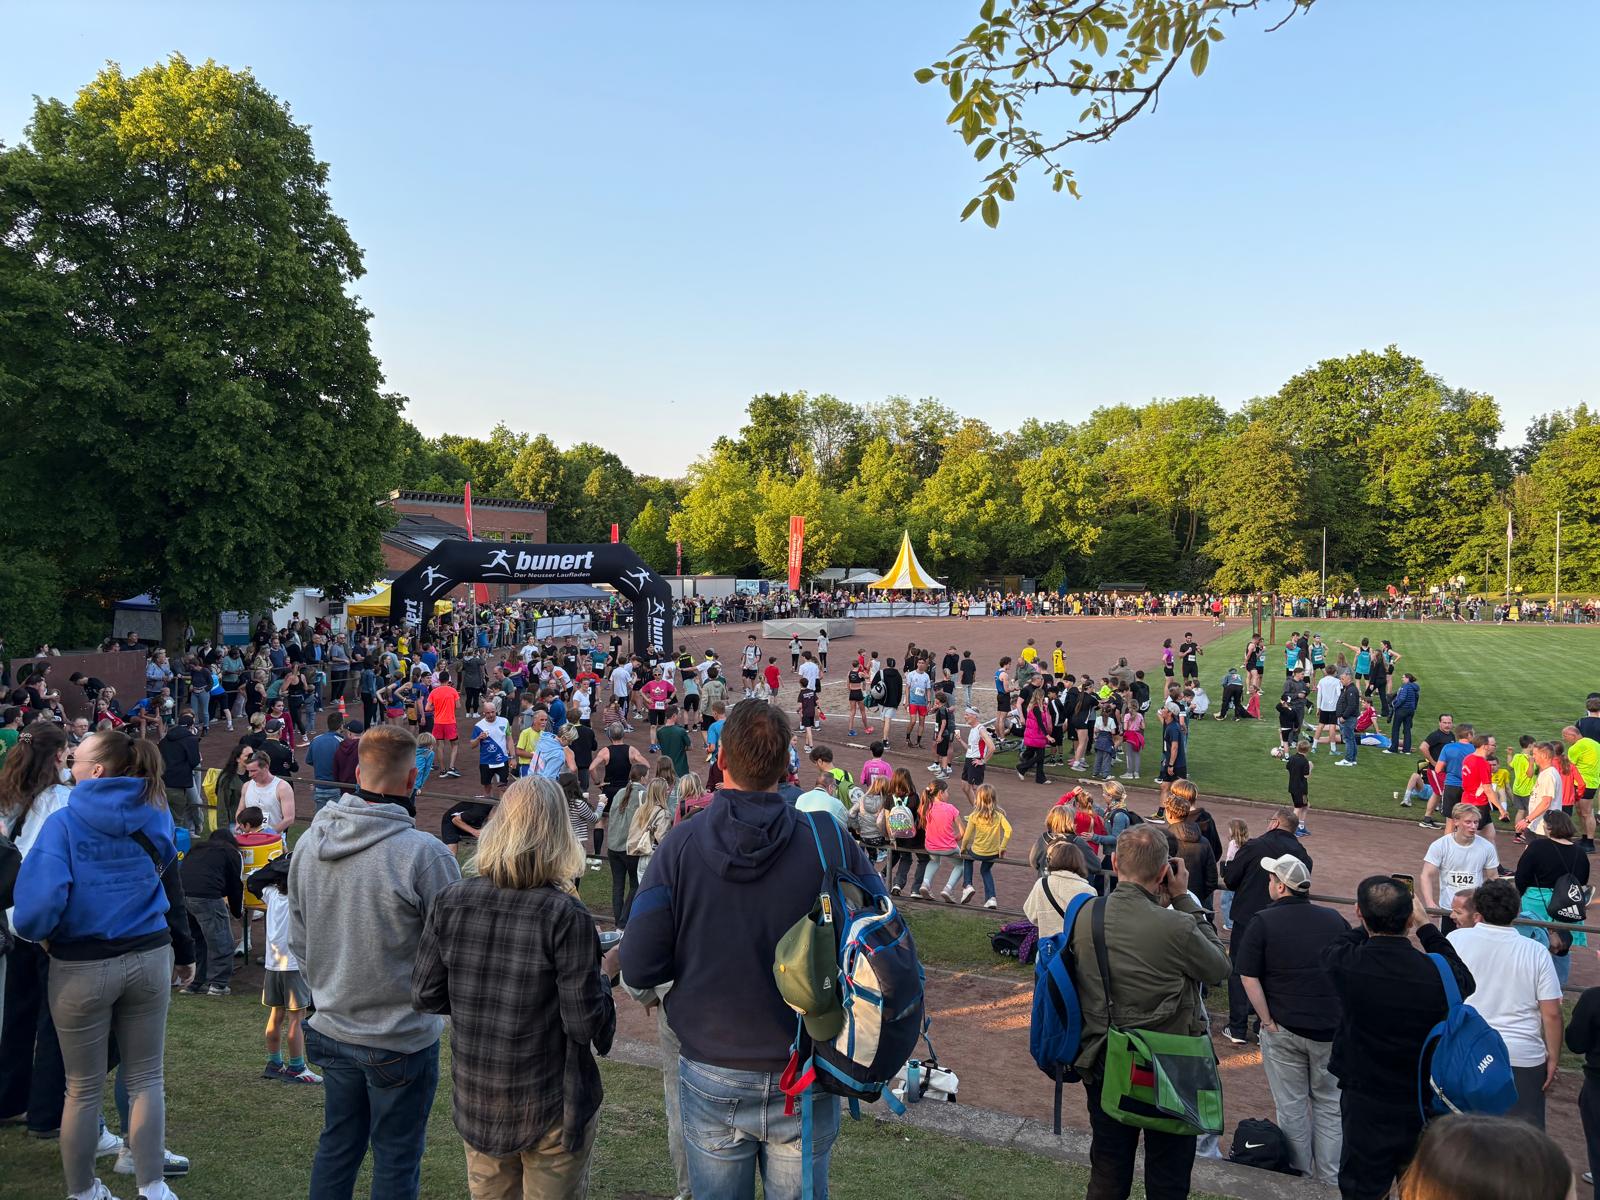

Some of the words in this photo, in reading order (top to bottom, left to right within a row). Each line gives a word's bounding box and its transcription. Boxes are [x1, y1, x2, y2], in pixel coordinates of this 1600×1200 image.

[515, 551, 594, 570] bunert
[1451, 875, 1474, 884] 1242
[1557, 910, 1582, 920] adidas
[1477, 1054, 1494, 1074] JAKO
